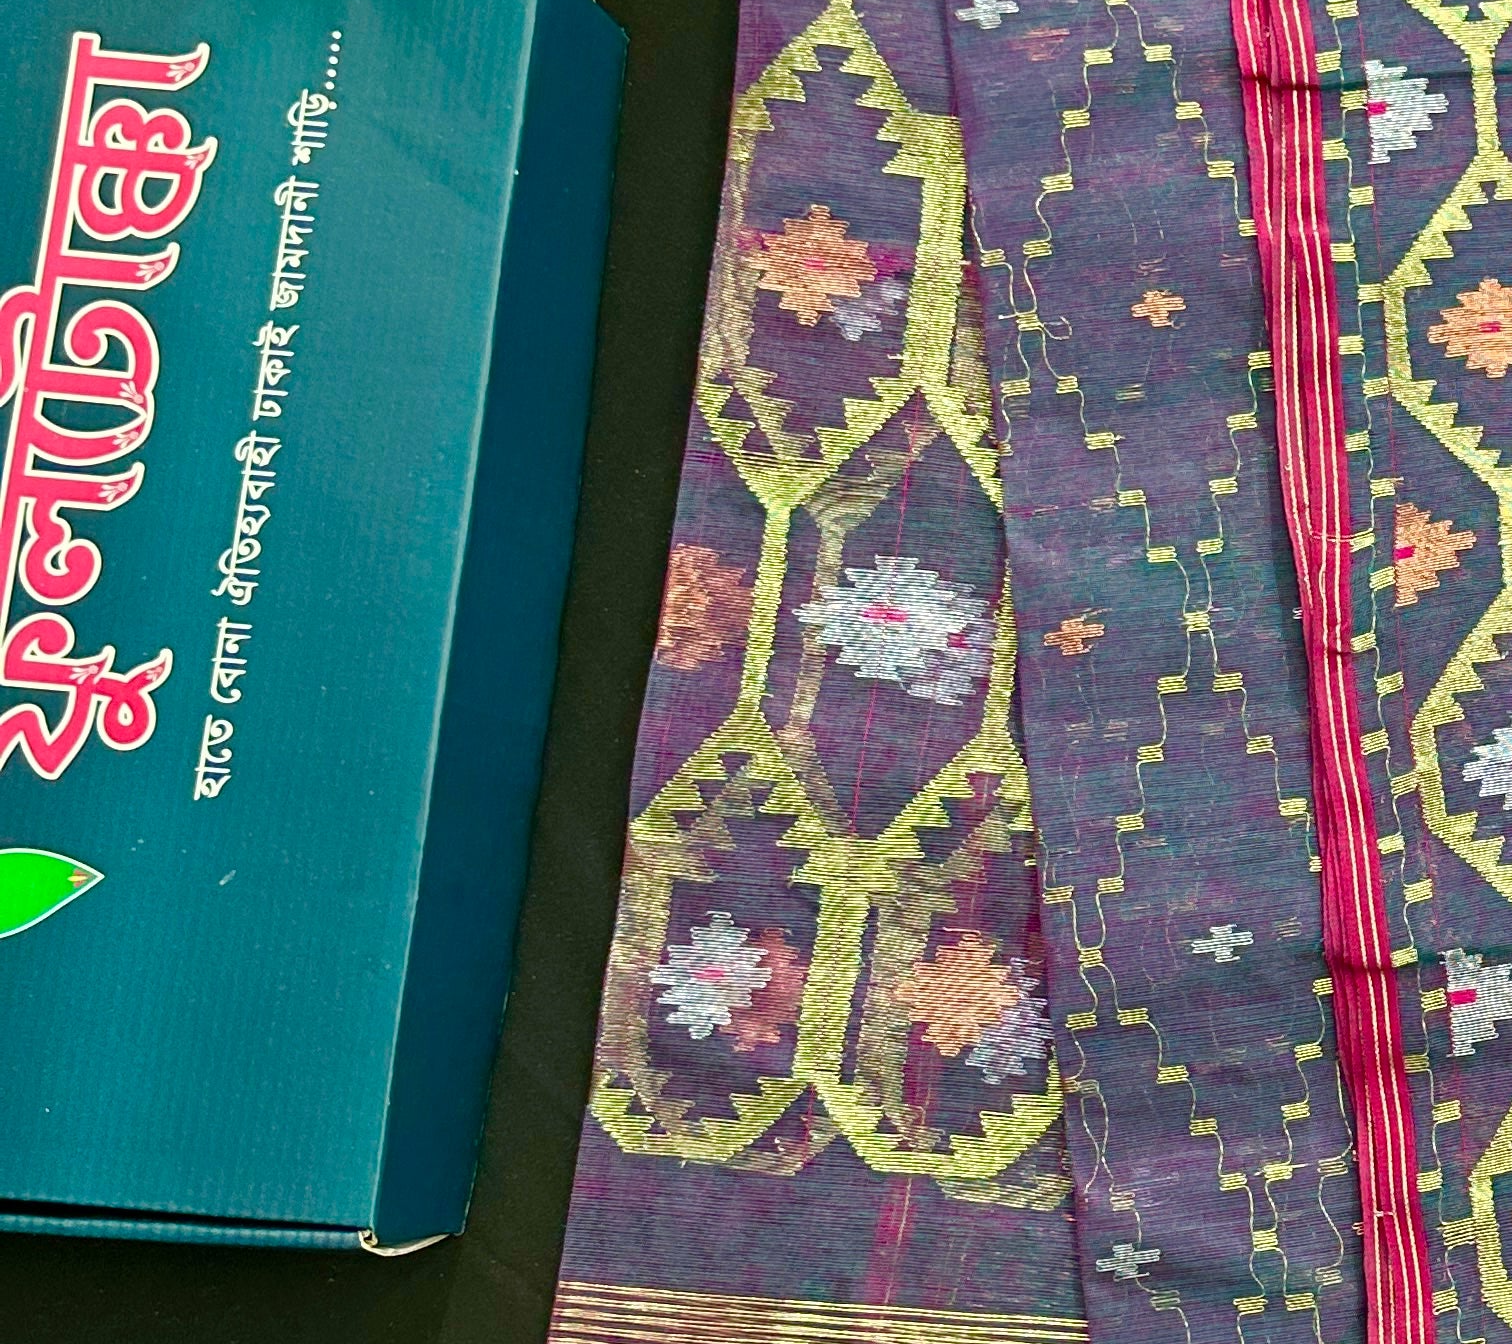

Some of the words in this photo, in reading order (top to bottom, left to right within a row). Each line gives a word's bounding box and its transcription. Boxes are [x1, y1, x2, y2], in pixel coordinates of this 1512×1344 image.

[268, 174, 320, 312] জামদানী
[250, 320, 300, 422] ঢাকাই
[210, 429, 282, 606] ঐতিহ্যবাহী
[209, 616, 253, 704] বোনা
[193, 714, 234, 801] হাতে
